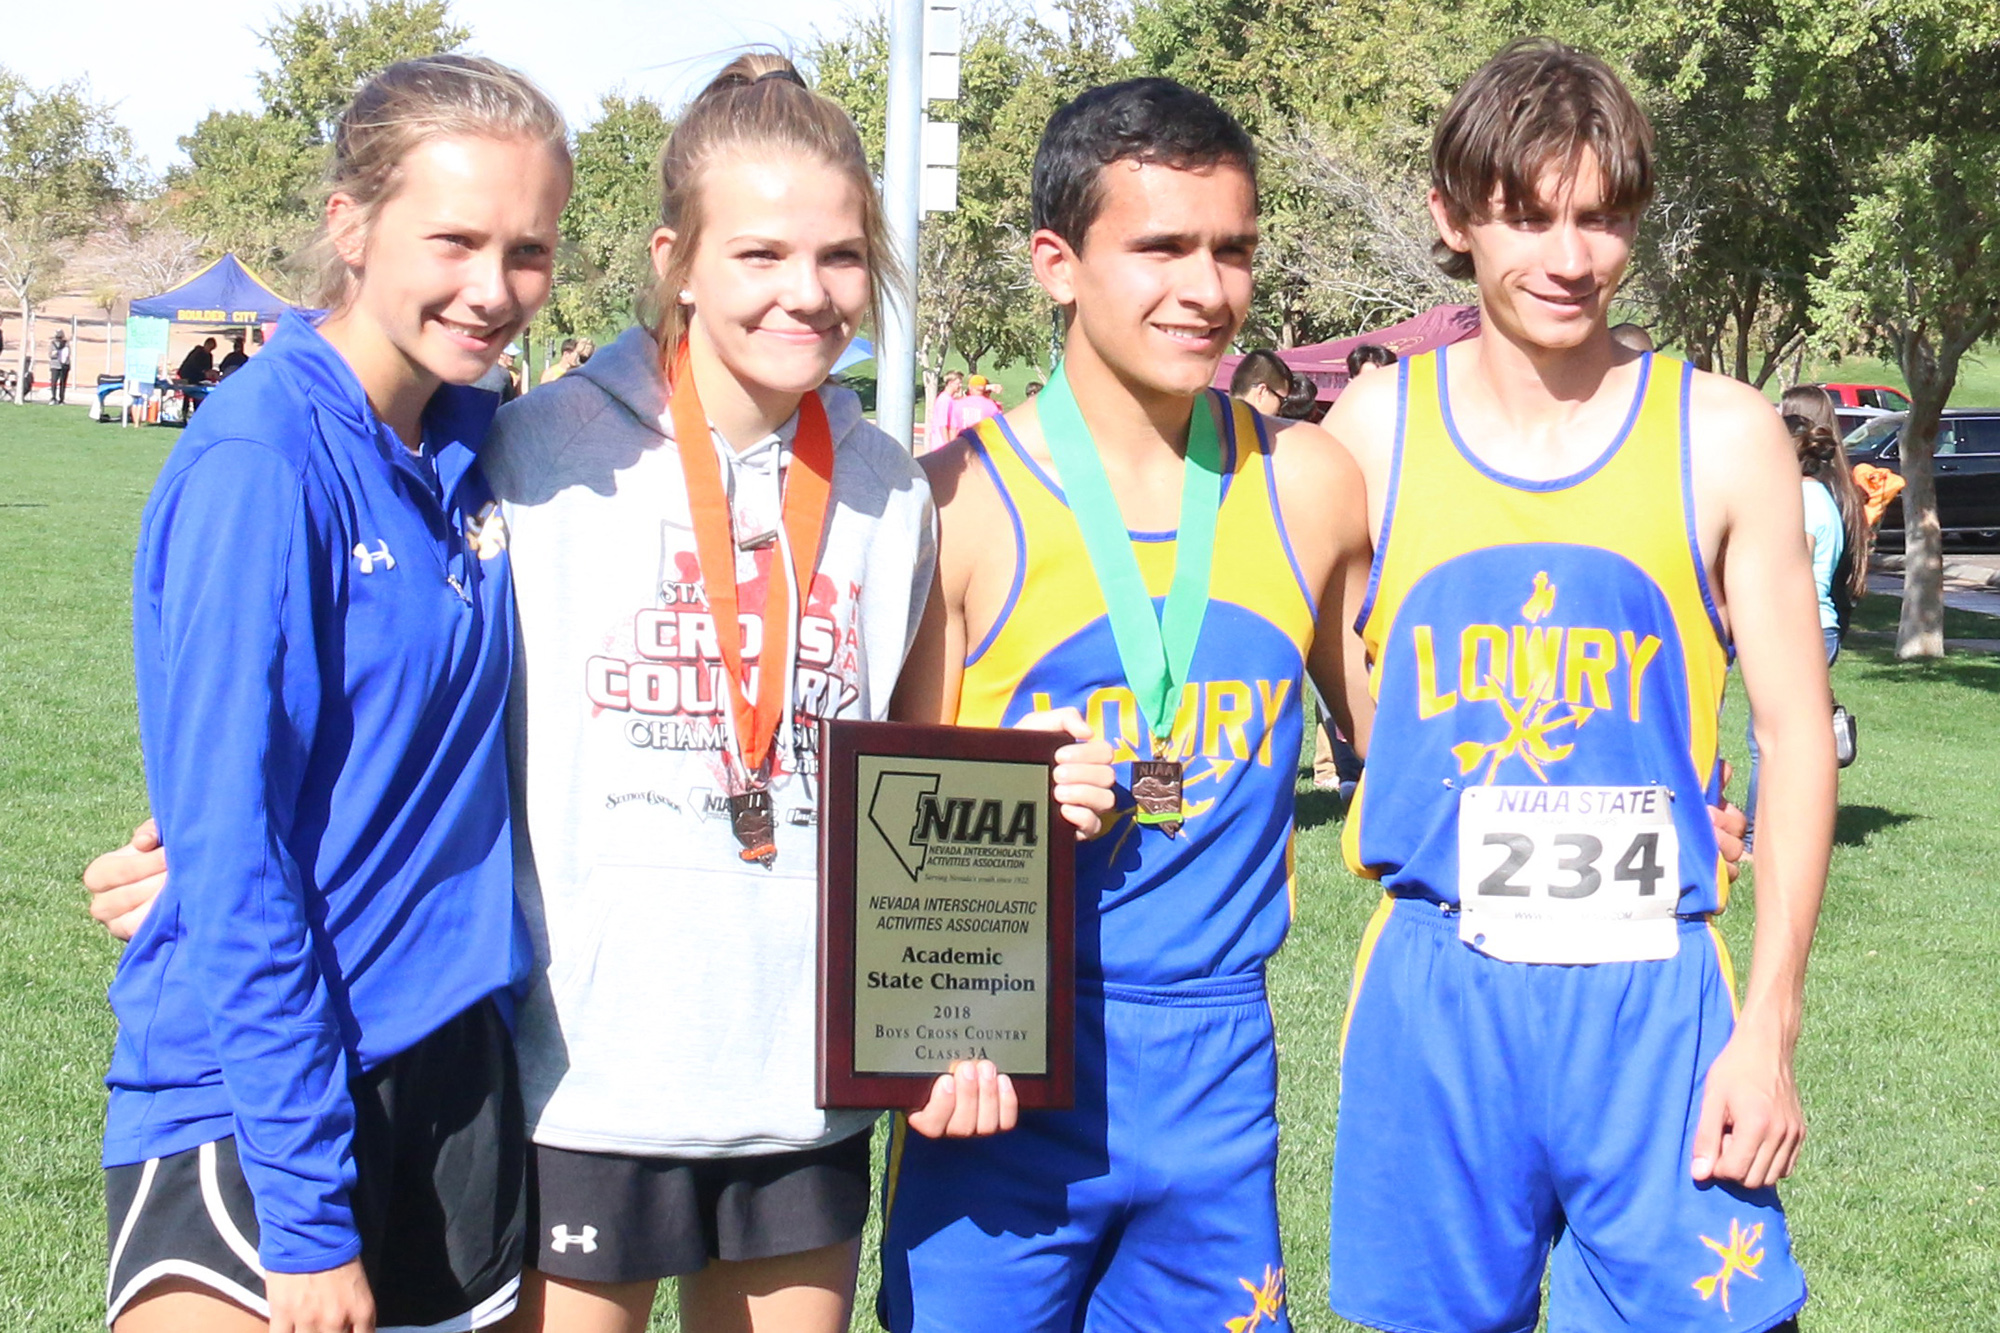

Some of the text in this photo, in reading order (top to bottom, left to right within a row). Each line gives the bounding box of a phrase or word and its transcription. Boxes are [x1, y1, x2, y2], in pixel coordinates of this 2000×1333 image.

[176, 309, 258, 323] BOULDER CITY
[660, 580, 711, 608] STA
[634, 608, 837, 668] CROS
[1413, 623, 1663, 723] LOWRY
[585, 654, 859, 723] COUNRY
[1032, 679, 1292, 767] OWRY
[1496, 789, 1657, 814] NIAA STATE
[914, 797, 1038, 846] NIAA
[928, 845, 1034, 859] NEVADA INTERSCHOLASTIC
[926, 857, 1026, 869] ACTIVITIES ASSOCIATION
[1477, 831, 1665, 899] 234
[869, 896, 1037, 915] NEVADA INTERSCHOLASTIC
[876, 916, 1029, 934] ACTIVITIES ASSOCIATION
[901, 946, 1003, 965] Academic
[867, 971, 1036, 995] State Champion
[933, 1005, 971, 1019] 2018
[875, 1024, 1028, 1041] BOYS CROSS COUNTRY
[915, 1045, 989, 1060] CLASS 3A
